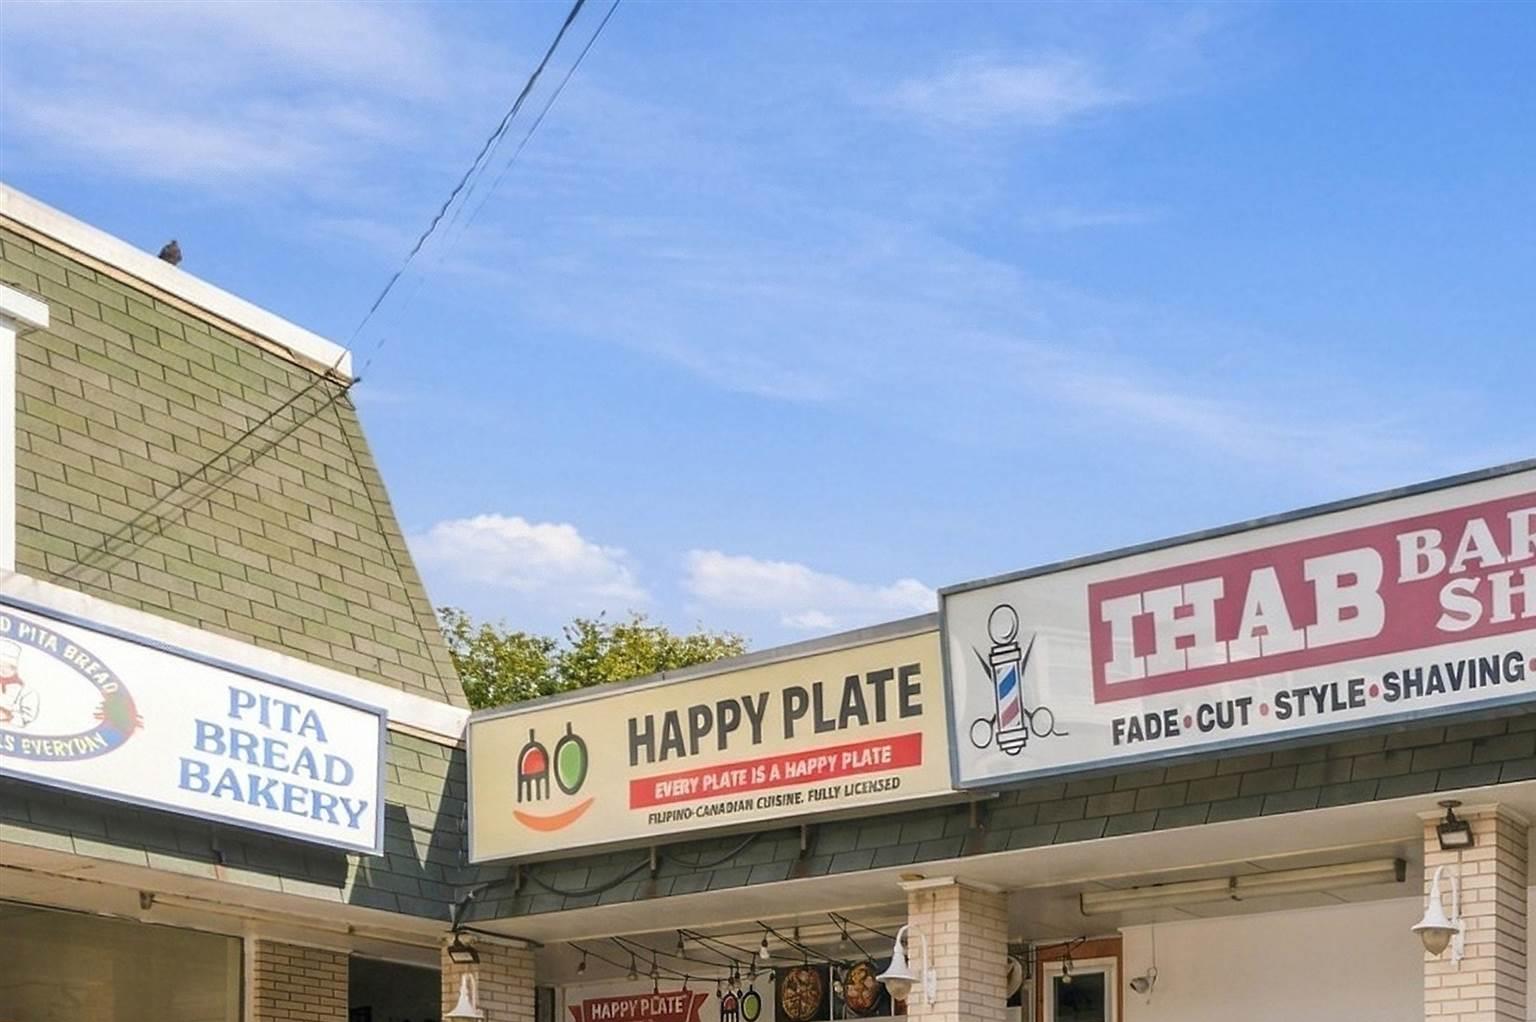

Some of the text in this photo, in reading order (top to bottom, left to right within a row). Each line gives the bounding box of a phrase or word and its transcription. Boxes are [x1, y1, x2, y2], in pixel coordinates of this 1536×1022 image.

[1101, 545, 1386, 685] IHAB
[18, 622, 58, 652] PITA
[63, 645, 119, 695] BREAD
[228, 686, 328, 743] PITA
[628, 663, 923, 766] HAPPY PLATE
[1111, 708, 1181, 746] FADE
[1198, 697, 1253, 732] CUT
[1274, 677, 1366, 720] STYLE
[1382, 650, 1525, 702] SHAVING
[21, 731, 109, 757] EVERYDAY
[194, 718, 354, 787] BREAD
[655, 745, 892, 799] EVERY PLATE IS A HAPPY PLATE
[178, 757, 369, 829] BAKERY
[648, 776, 901, 825] FILIPINO-CANADIAN CUISINE. FULLY LICENSED
[592, 996, 684, 1020] HAPPY PLATE
